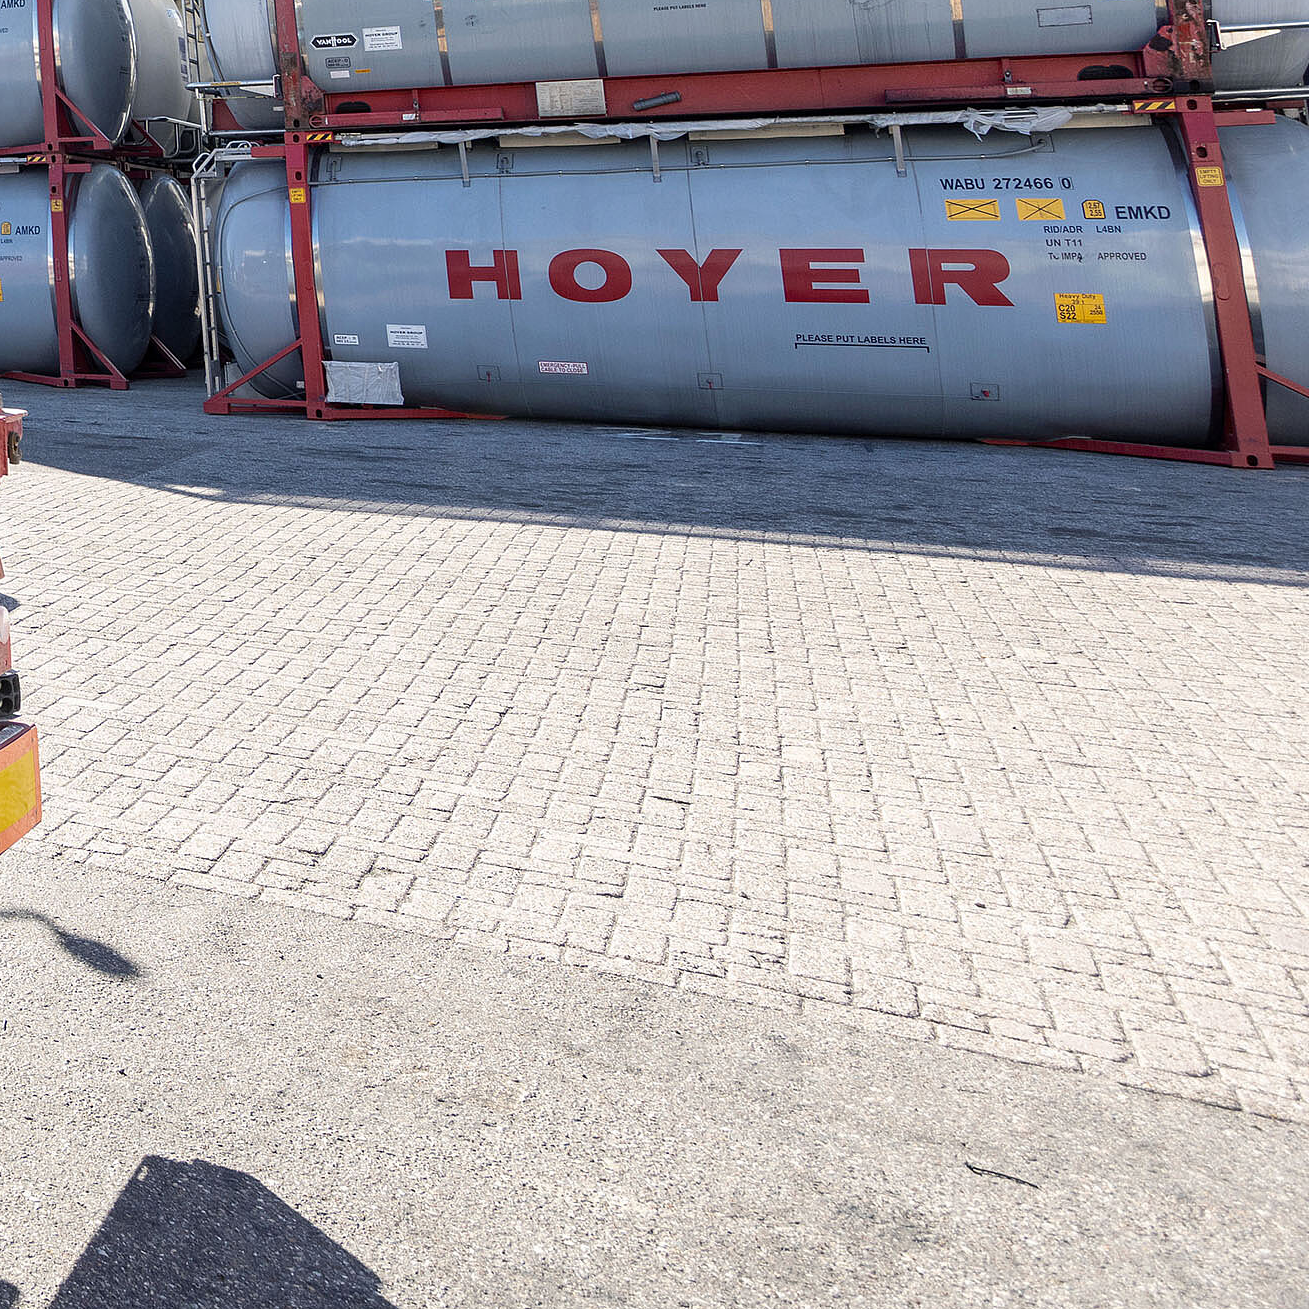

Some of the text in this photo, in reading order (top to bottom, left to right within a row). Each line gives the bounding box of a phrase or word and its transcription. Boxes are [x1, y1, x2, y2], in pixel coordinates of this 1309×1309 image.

[316, 36, 352, 47] VANHOOL
[939, 177, 1071, 190] WABU 272466 0
[1115, 205, 1171, 219] EMKD
[15, 225, 41, 235] AMKD
[1043, 225, 1121, 233] RID/ADR L4BN
[1045, 238, 1082, 246] UN T11
[1097, 252, 1146, 260] APPROVED
[445, 247, 1013, 307] HOYER
[1060, 312, 1077, 320] S22
[796, 334, 926, 345] PLEASE PUT LABELS HERE
